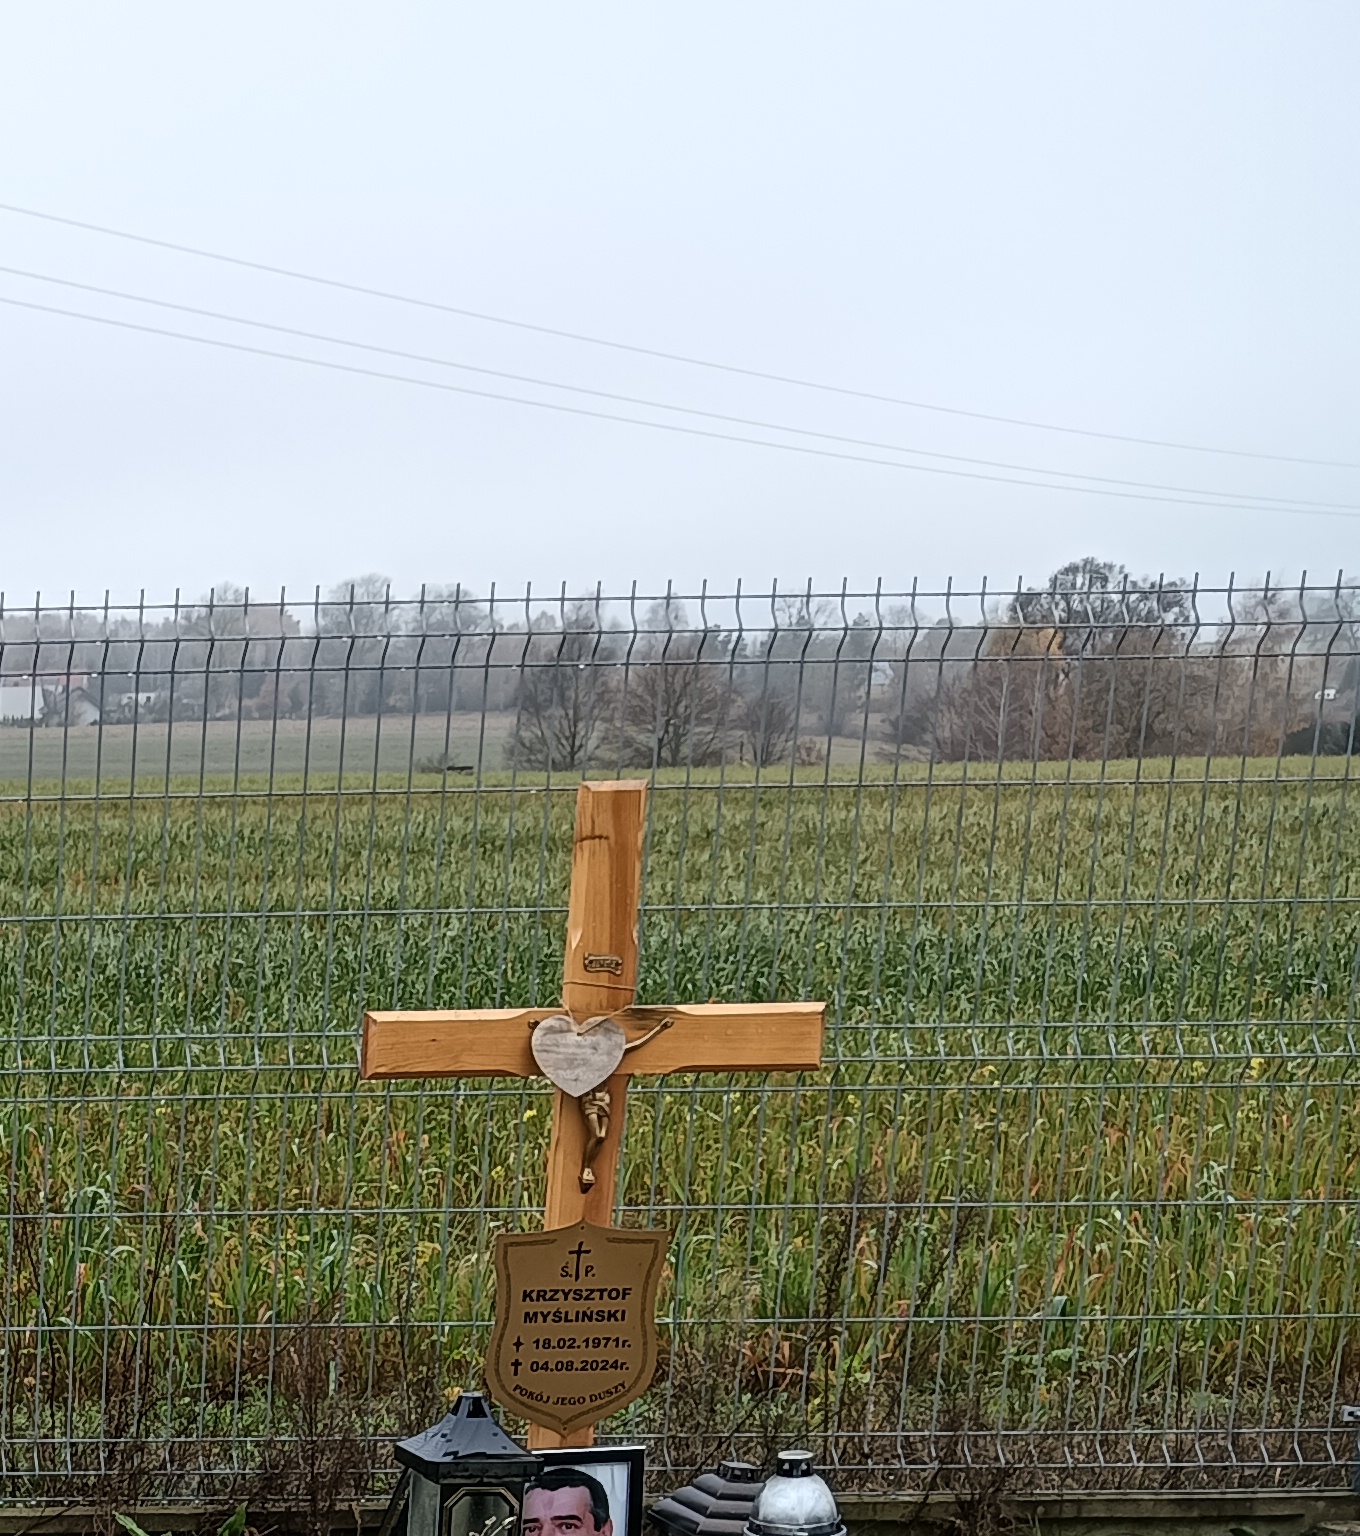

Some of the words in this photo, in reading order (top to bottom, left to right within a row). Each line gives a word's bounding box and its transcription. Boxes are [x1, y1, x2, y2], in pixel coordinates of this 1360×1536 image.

[584, 1265, 596, 1278] P.
[521, 1287, 632, 1303] KRZYSZTOF
[523, 1307, 626, 1324] MYŚLIŃSKI
[532, 1336, 632, 1350] 18.02.1971r.
[530, 1359, 630, 1373] 04.08.2024r.
[512, 1383, 550, 1404] POKÓJ
[552, 1396, 586, 1406] JEGO
[589, 1380, 628, 1402] DUSZY
